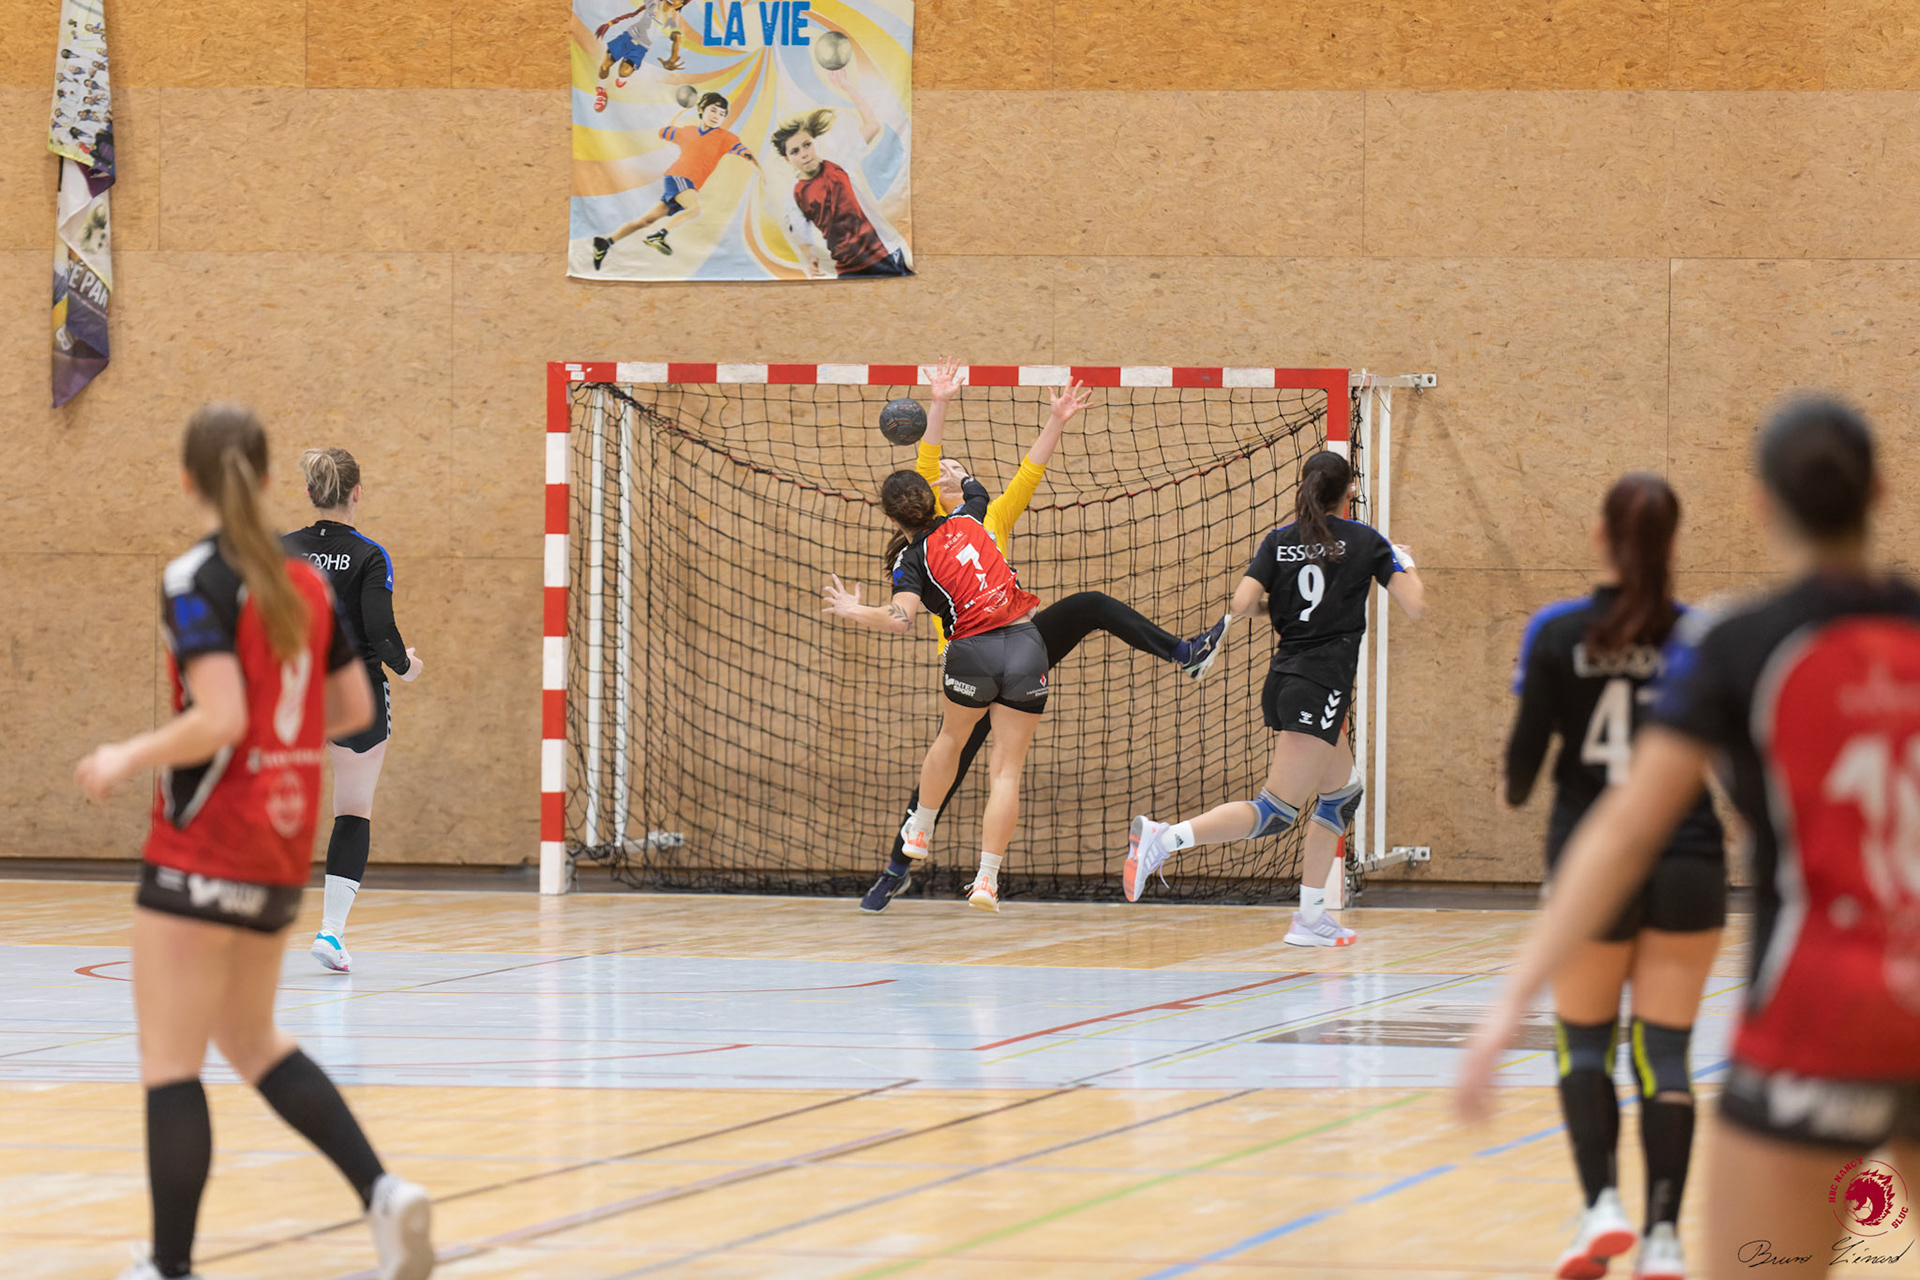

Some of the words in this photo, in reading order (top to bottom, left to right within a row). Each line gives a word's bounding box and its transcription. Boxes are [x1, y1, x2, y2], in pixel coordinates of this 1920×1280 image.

[703, 1, 746, 46] LA
[758, 1, 811, 46] VIE
[956, 543, 988, 591] 7
[1297, 564, 1326, 622] 9
[953, 680, 977, 693] INTER
[953, 685, 976, 698] SPORT
[1580, 678, 1632, 788] 4
